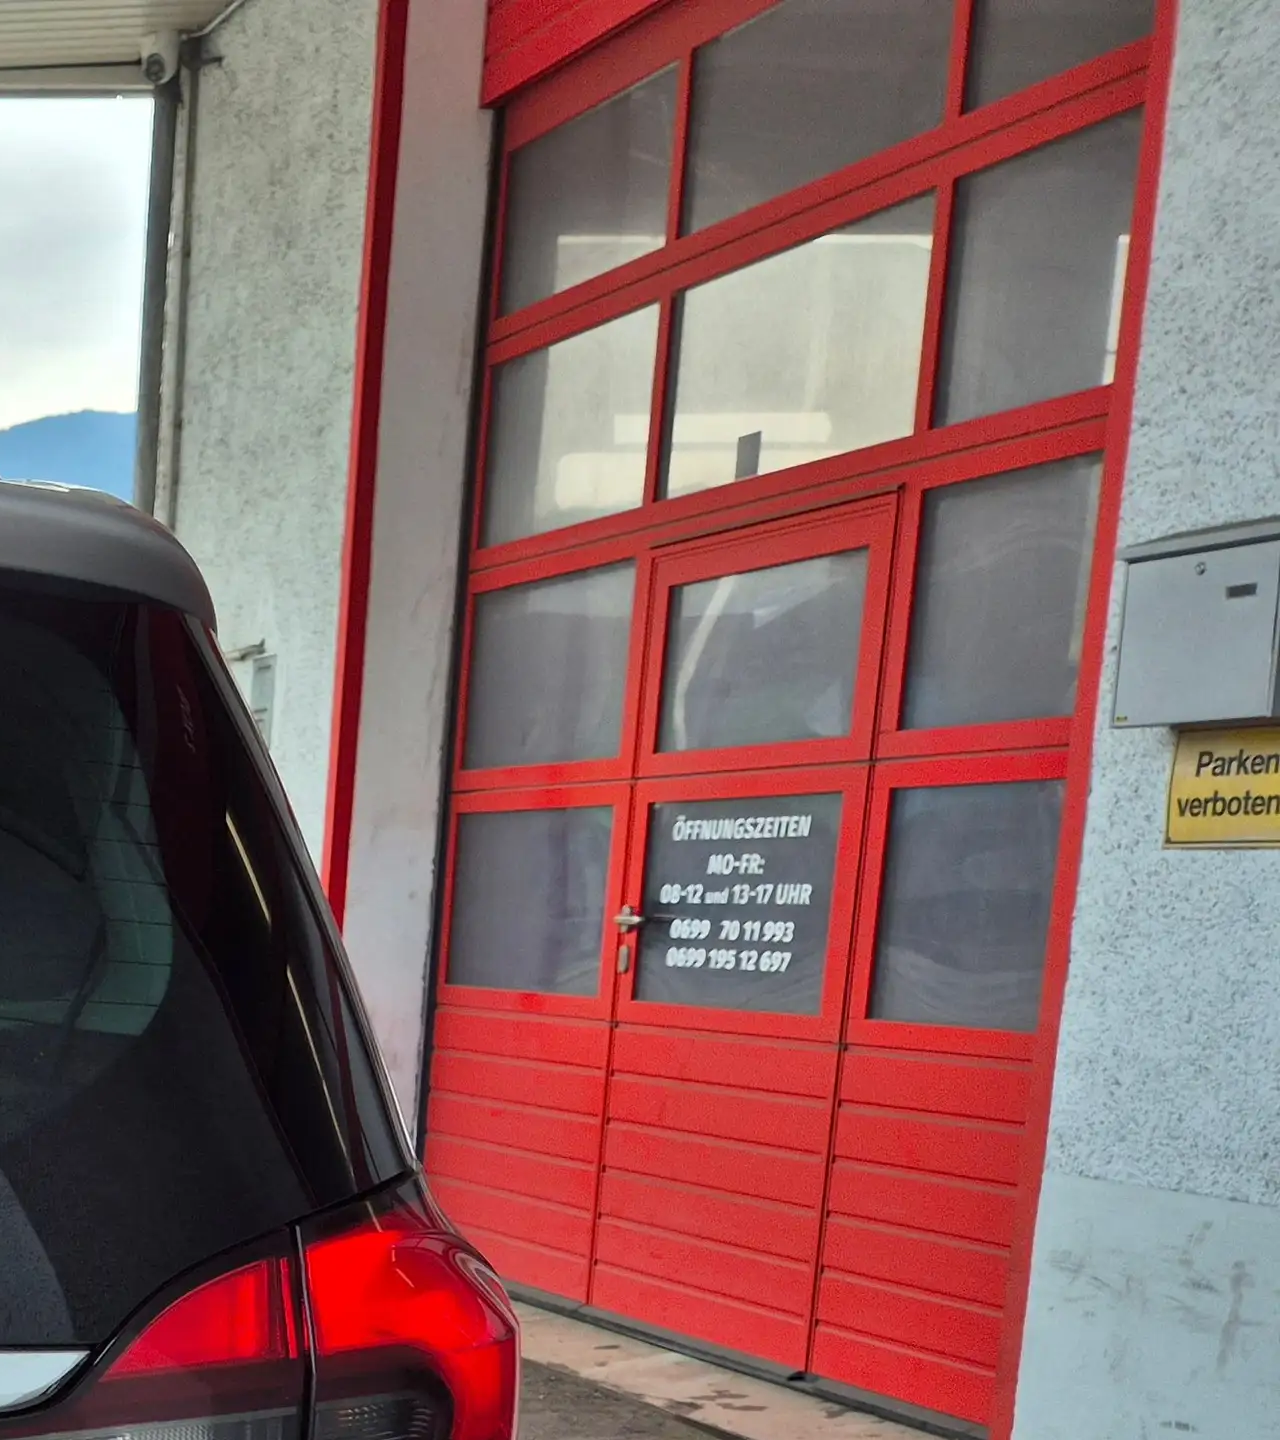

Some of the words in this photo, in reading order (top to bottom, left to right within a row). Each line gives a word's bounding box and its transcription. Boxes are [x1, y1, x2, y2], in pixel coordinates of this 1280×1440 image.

[1195, 749, 1280, 778] Parken
[1177, 789, 1280, 818] verboten
[672, 815, 812, 841] ÖFFNUNGSZEITEN
[707, 853, 766, 875] MO-FR:
[659, 883, 704, 904] 08-12
[704, 886, 729, 905] und
[732, 883, 774, 904] 13-17
[775, 883, 813, 905] UHR
[669, 919, 711, 940] 0699
[719, 920, 741, 940] 70
[743, 920, 762, 942] 11
[762, 921, 795, 943] 993
[665, 946, 707, 968] 0699
[708, 949, 736, 970] 195
[739, 950, 758, 971] 12
[759, 951, 792, 973] 697
